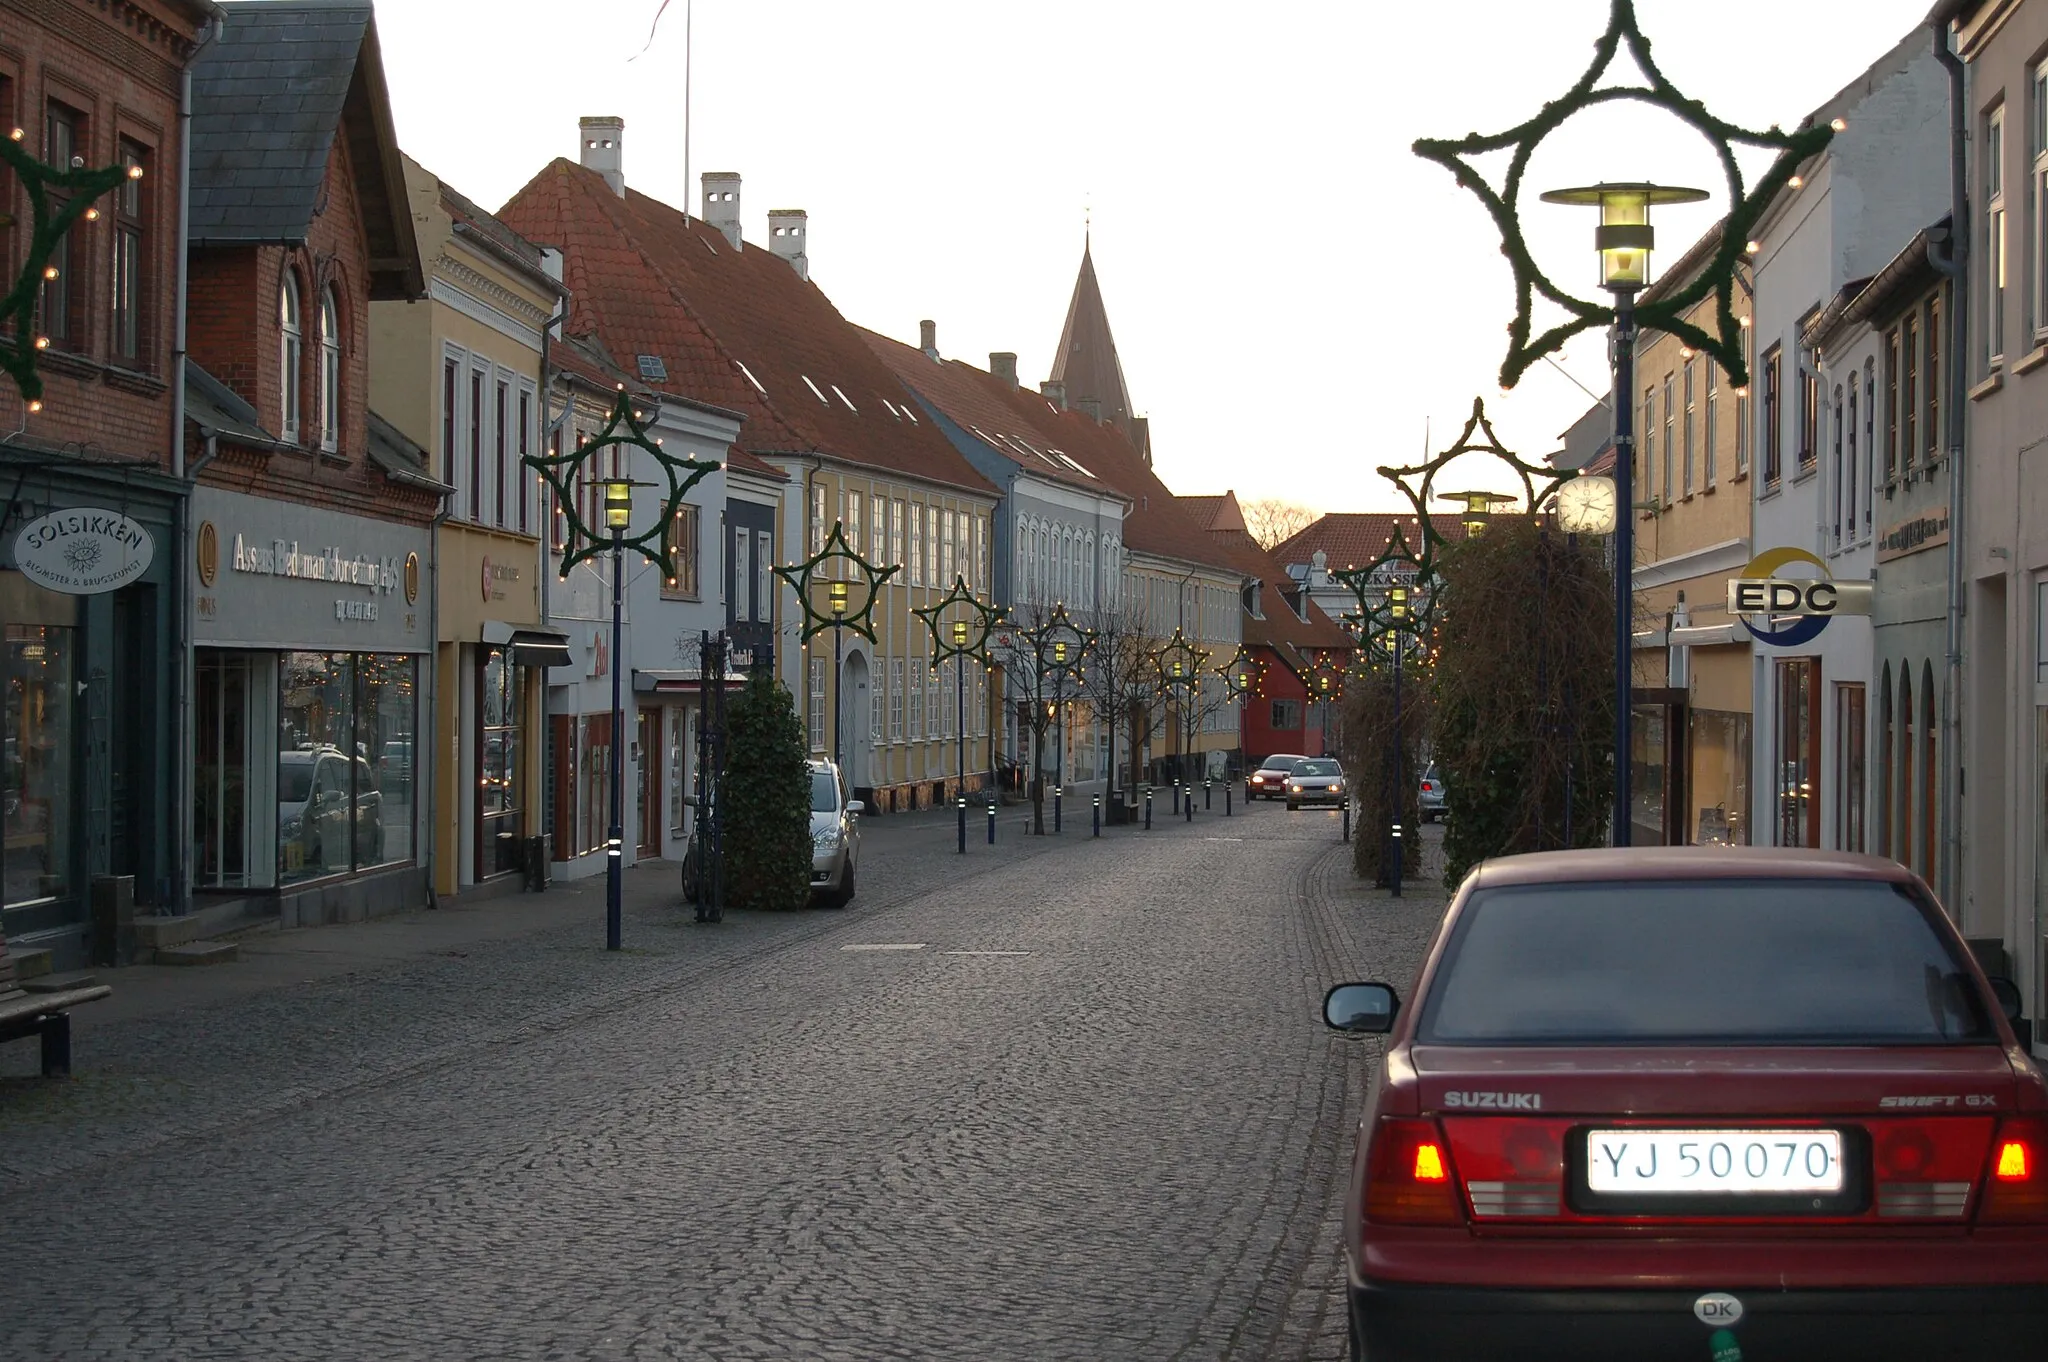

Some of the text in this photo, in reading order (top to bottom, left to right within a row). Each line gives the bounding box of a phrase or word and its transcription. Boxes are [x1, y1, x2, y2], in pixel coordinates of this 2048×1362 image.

[27, 516, 142, 550] SOLSIKKEN
[233, 532, 274, 576] Assens
[25, 559, 70, 584] BLOMSTER
[83, 560, 141, 586] BRUGSKUNST
[1327, 573, 1419, 585] SREKASSE
[1736, 583, 1837, 612] EDC
[1444, 1091, 1541, 1109] SUZUKI
[1879, 1094, 1997, 1107] SWIFT GX
[1602, 1143, 1657, 1178] YJ
[1703, 1302, 1733, 1316] DK
